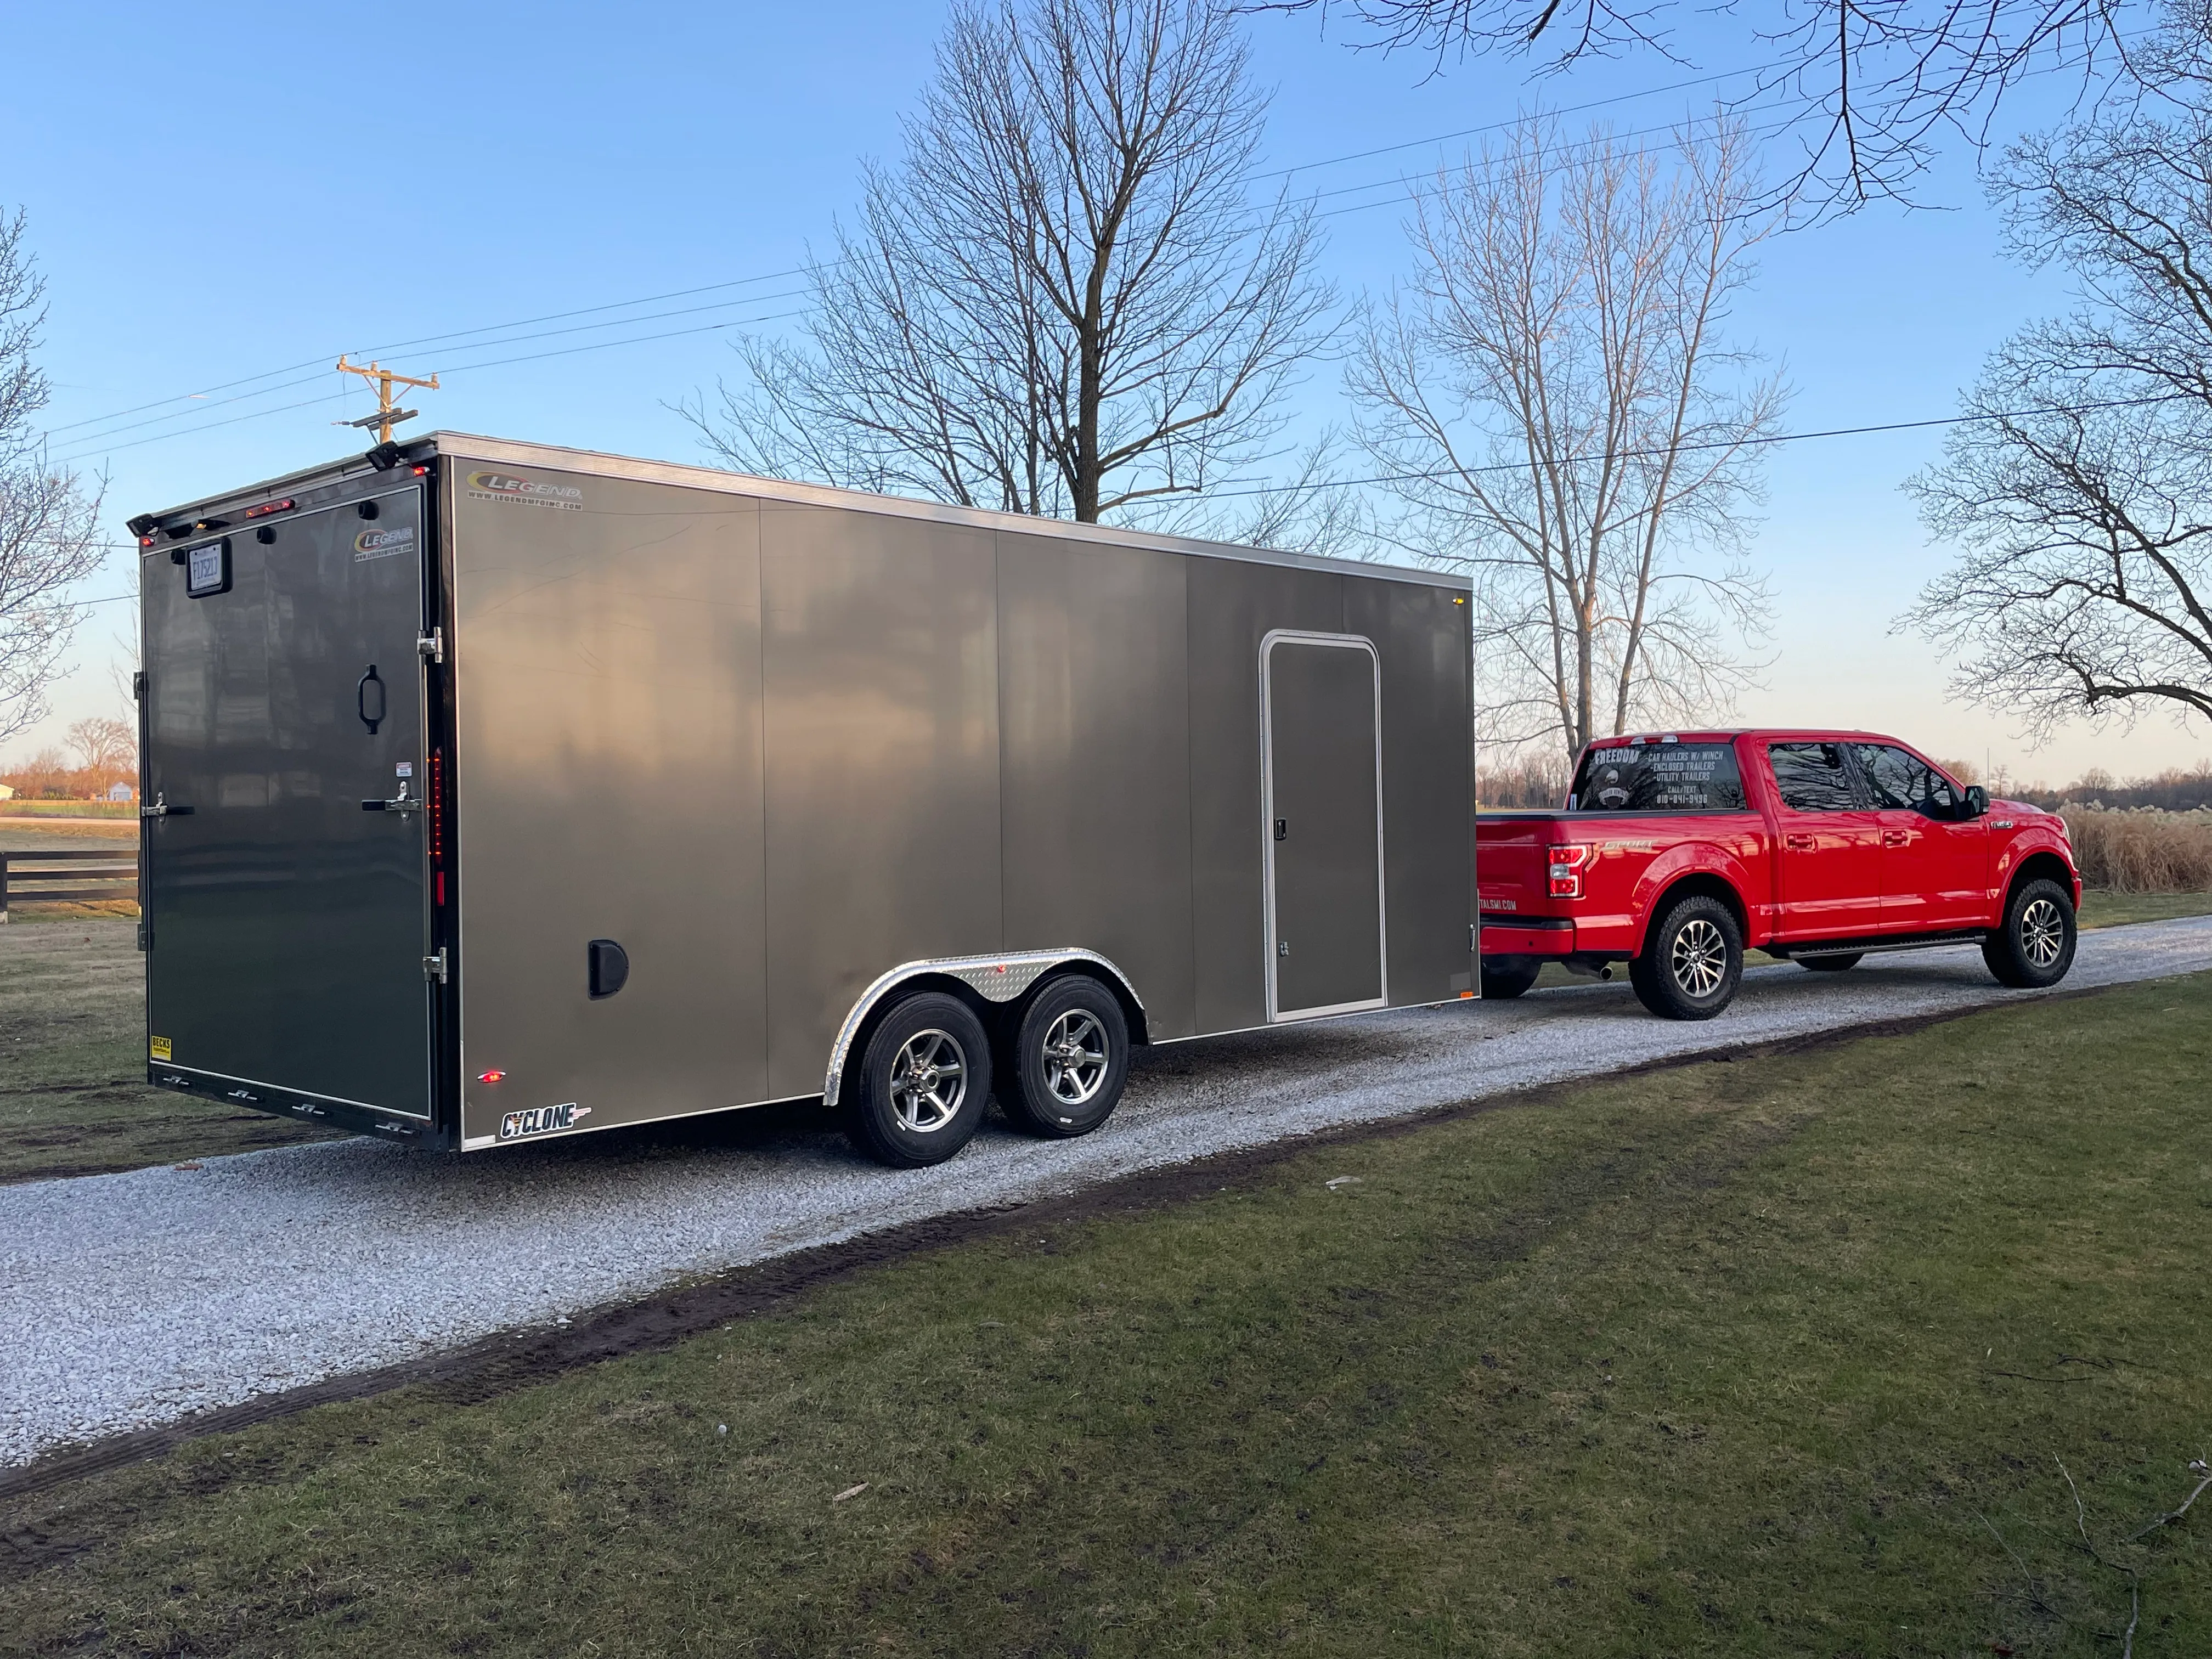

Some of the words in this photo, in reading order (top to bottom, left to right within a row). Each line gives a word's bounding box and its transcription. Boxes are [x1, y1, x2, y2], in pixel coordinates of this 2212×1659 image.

[488, 476, 581, 498] LEGEND
[468, 491, 582, 510] WWW.LEGENDMFGINC.COM
[364, 527, 413, 548] LEGEND
[1594, 748, 1640, 765] FREEDOM
[1662, 752, 1689, 761] HAULERS
[1691, 752, 1700, 761] W/
[1702, 751, 1723, 760] WINCH
[1686, 761, 1716, 771] TRAILERS
[1681, 771, 1711, 781] TRAILERS
[153, 1037, 170, 1049] BECKS
[501, 1104, 575, 1137] CYCLONE
